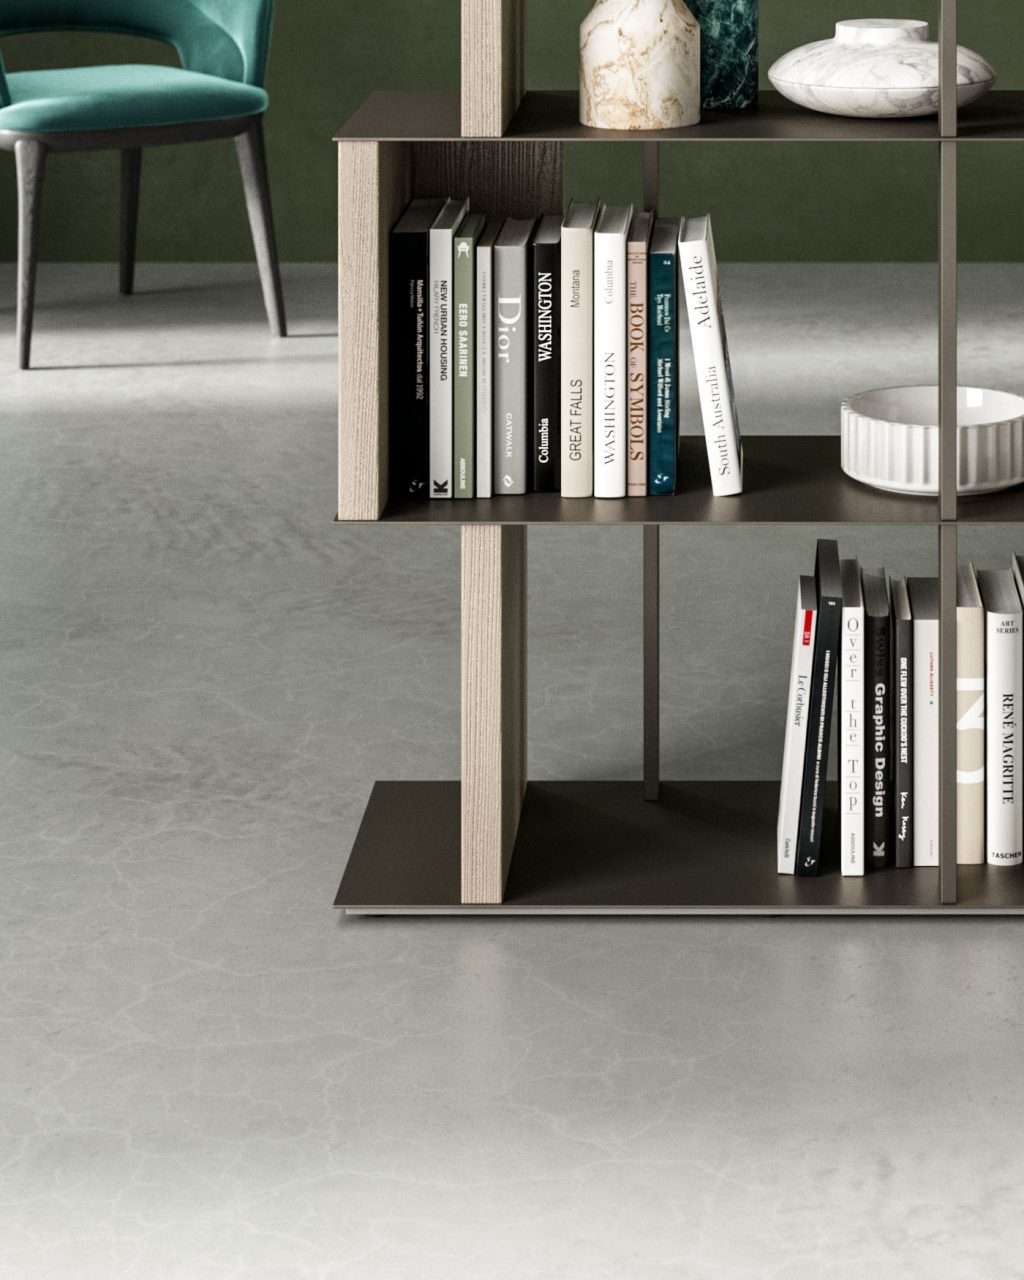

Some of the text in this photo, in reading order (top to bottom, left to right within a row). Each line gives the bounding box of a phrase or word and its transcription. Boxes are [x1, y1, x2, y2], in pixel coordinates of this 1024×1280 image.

[416, 279, 424, 307] Mansilla
[537, 272, 553, 363] WASHINGTON
[570, 269, 581, 309] Montana
[688, 255, 712, 329] Adelaide
[415, 334, 424, 373] Arquitectos
[440, 280, 448, 381] NEW URBAN HOUSING
[458, 303, 468, 377] EERO SAARINEN
[497, 294, 522, 364] Dior
[629, 281, 645, 461] THE BOOK OF SYMBOLS
[538, 418, 550, 463] Columbia
[569, 379, 583, 462] GREAT FALLS
[604, 352, 616, 465] WASHINGTON
[707, 365, 733, 477] South Australia
[900, 657, 908, 670] ONE
[900, 670, 908, 687] FLEW
[900, 687, 908, 705] OVER
[794, 675, 808, 727] Le Corbusier
[848, 618, 859, 811] Over the Top
[872, 683, 886, 753] Graphic
[900, 705, 908, 717] THE
[1002, 693, 1016, 805] RENÉ MAGRITTE
[872, 758, 886, 818] Design
